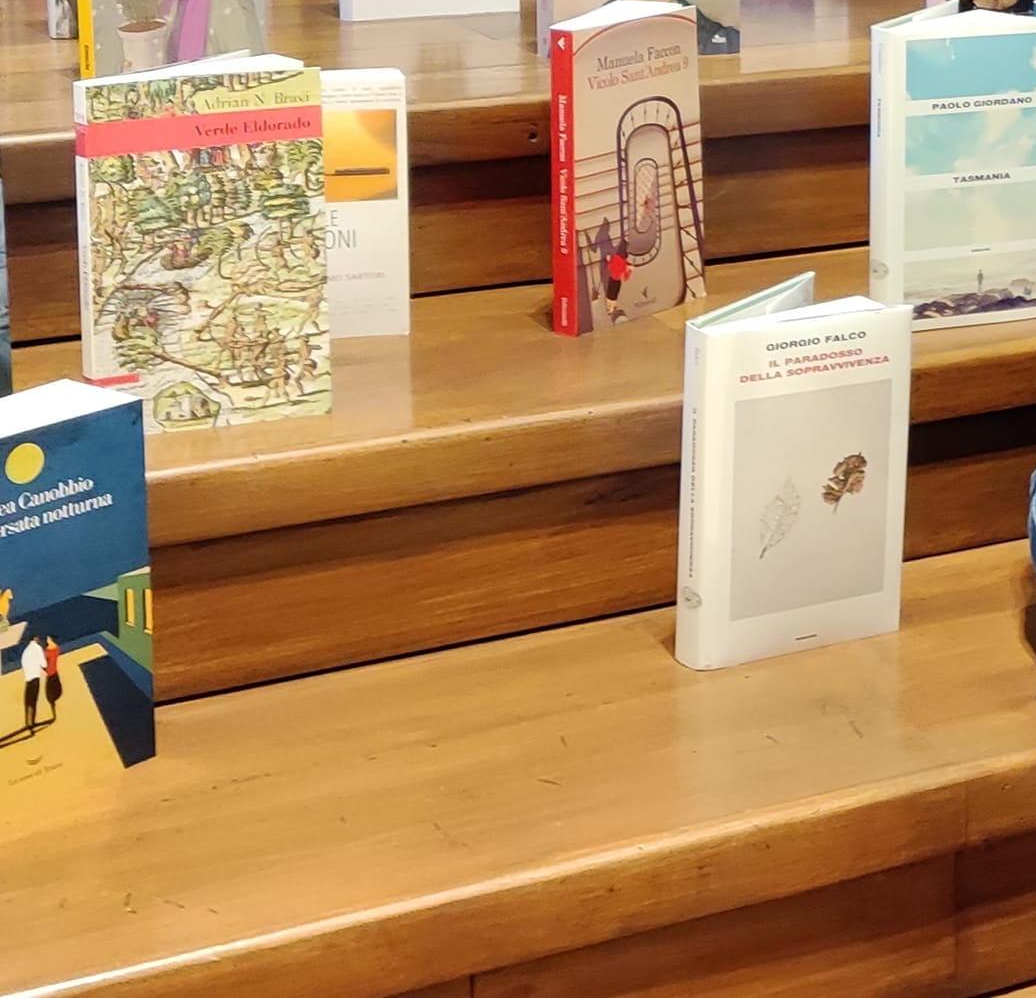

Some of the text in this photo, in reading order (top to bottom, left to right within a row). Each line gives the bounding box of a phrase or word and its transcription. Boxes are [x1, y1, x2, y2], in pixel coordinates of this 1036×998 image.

[595, 49, 644, 73] Manuela
[586, 72, 619, 90] Vicolo
[682, 55, 689, 70] 9
[202, 92, 250, 112] Adrian
[931, 96, 1033, 111] PAOLO GIORDANO
[193, 116, 312, 139] Verde Eldorado
[953, 172, 1011, 184] TASMANIA
[325, 229, 357, 250] ONI
[766, 330, 867, 352] GIORGIO FALCO
[769, 347, 864, 369] IL PARADOSSO
[739, 355, 891, 384] DELLA SOPRAVVIVENZA
[0, 476, 95, 517] ea Canobbio
[0, 493, 114, 538] rsata notturna
